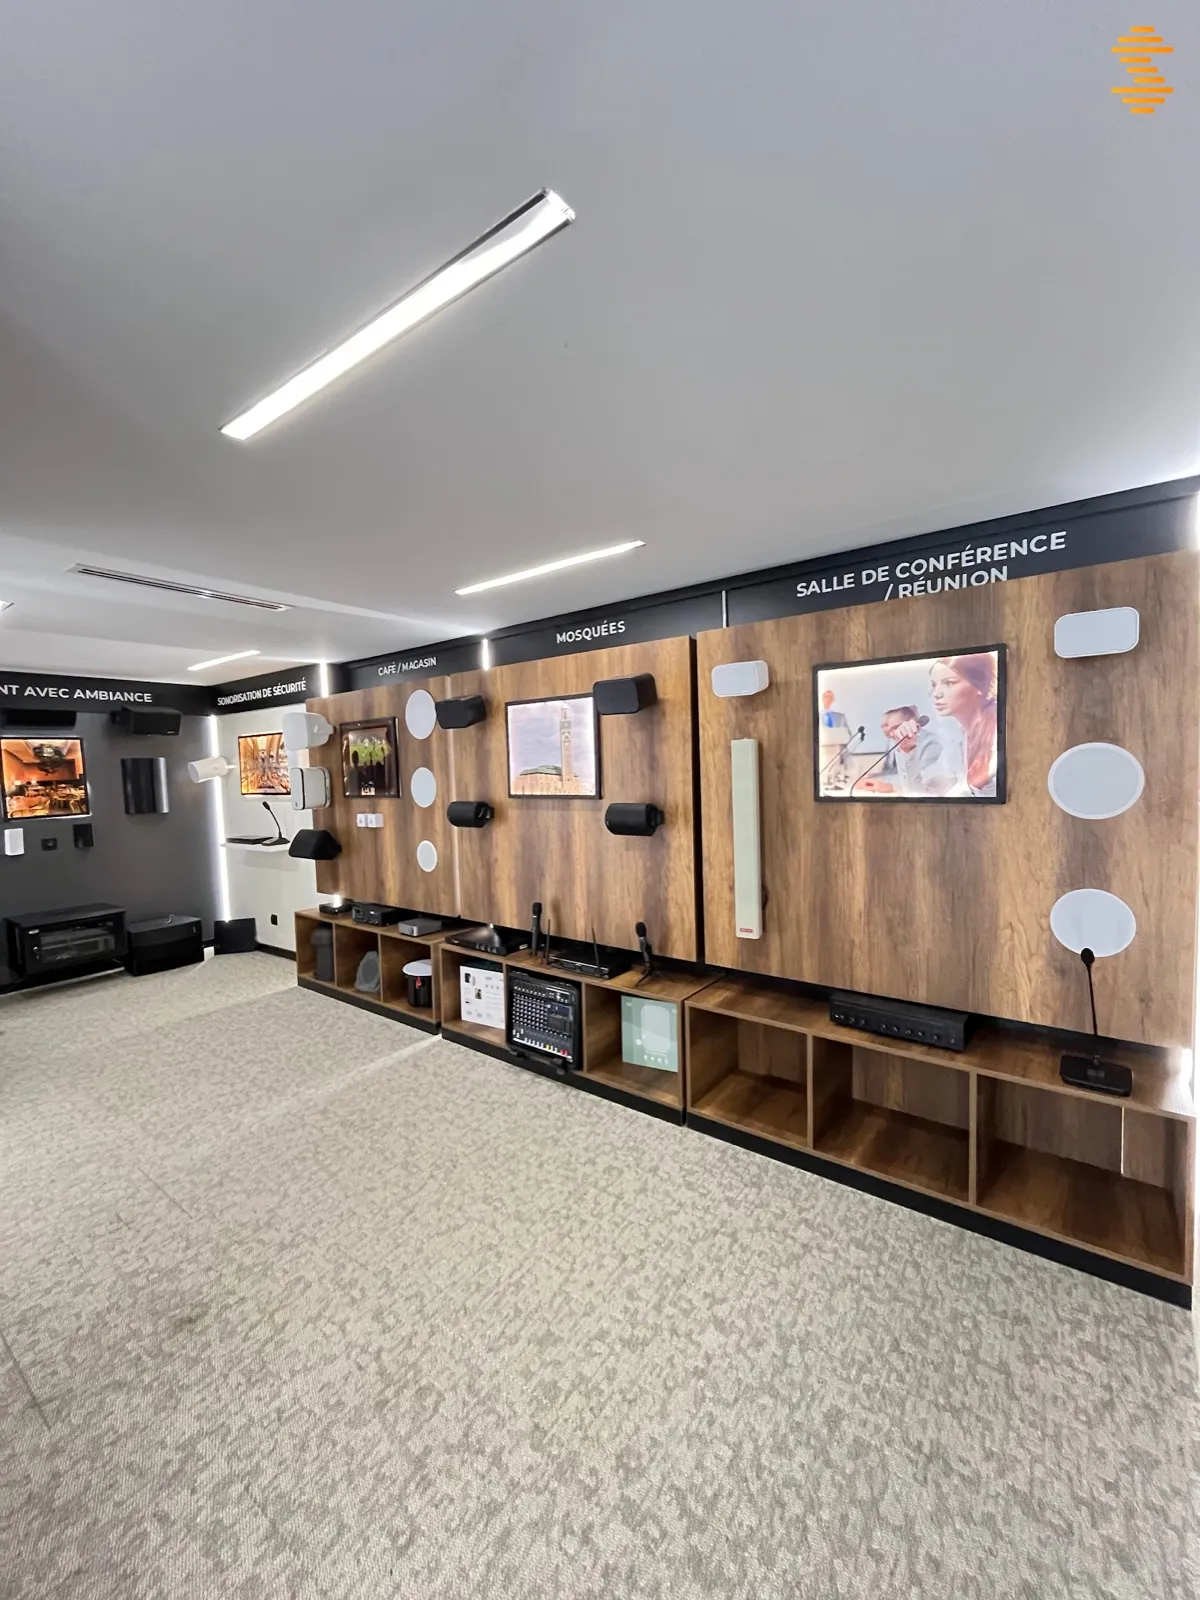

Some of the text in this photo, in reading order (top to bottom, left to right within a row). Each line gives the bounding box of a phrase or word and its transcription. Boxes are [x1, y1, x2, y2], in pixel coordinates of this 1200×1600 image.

[796, 530, 1067, 597] SALLE DE CONFÉRENCE
[898, 565, 1008, 599] RÉUNION
[556, 619, 626, 644] MOSQUÉES
[24, 686, 70, 699] AVEC
[73, 688, 153, 703] AMBIANCE
[217, 677, 307, 706] SONORISATION DE SÉCURITÉ
